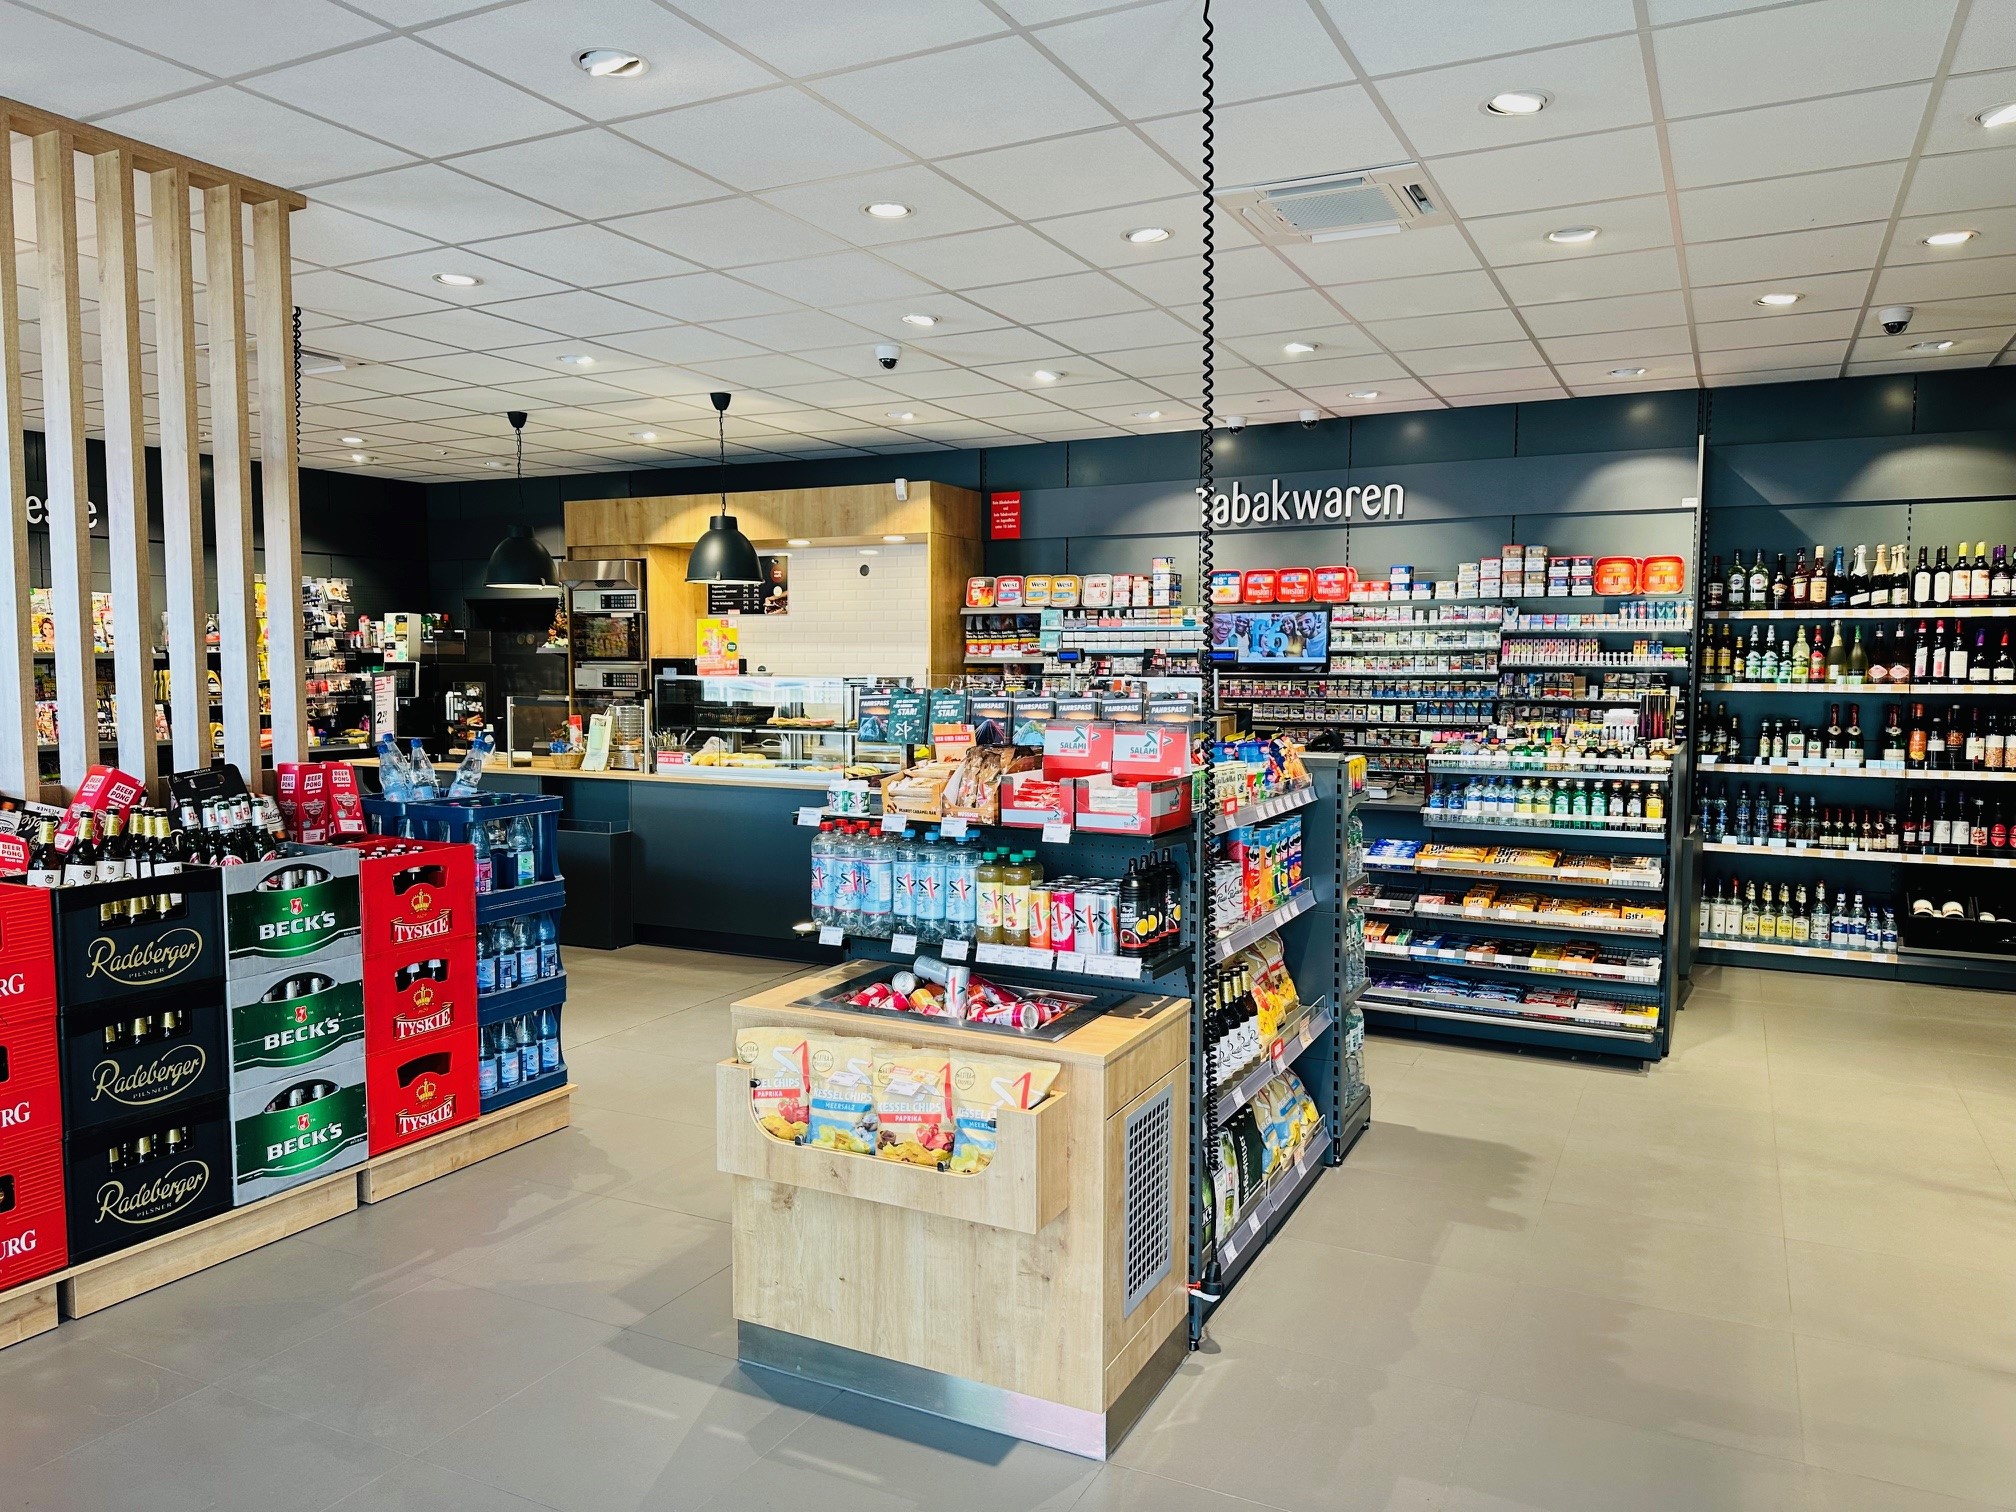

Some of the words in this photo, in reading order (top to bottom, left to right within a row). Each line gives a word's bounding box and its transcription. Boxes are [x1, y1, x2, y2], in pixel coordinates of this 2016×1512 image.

[1281, 587, 1304, 595] Winston
[1318, 586, 1341, 594] Winston
[111, 790, 130, 803] PONG
[116, 784, 133, 796] BEER
[259, 910, 336, 940] BECK'S
[394, 916, 448, 942] TYSKIE
[86, 932, 200, 981] Radeberger
[129, 968, 165, 978] PILSNER
[396, 1006, 450, 1039] TYSKIE
[264, 1017, 340, 1050] BECK'S
[91, 1052, 203, 1103] Radeberger
[774, 1078, 800, 1088] CHIPS
[132, 1086, 169, 1099] PILSNER
[813, 1088, 844, 1098] KESSEL
[845, 1091, 872, 1101] CHIPS
[825, 1102, 855, 1111] MEERSALZ
[877, 1102, 911, 1112] KESSEL
[913, 1103, 942, 1112] CHIPS
[399, 1100, 453, 1135] TYSKIE
[267, 1122, 343, 1162] BECK'S
[95, 1167, 206, 1223] Radeberger
[136, 1202, 172, 1217] PILSNER
